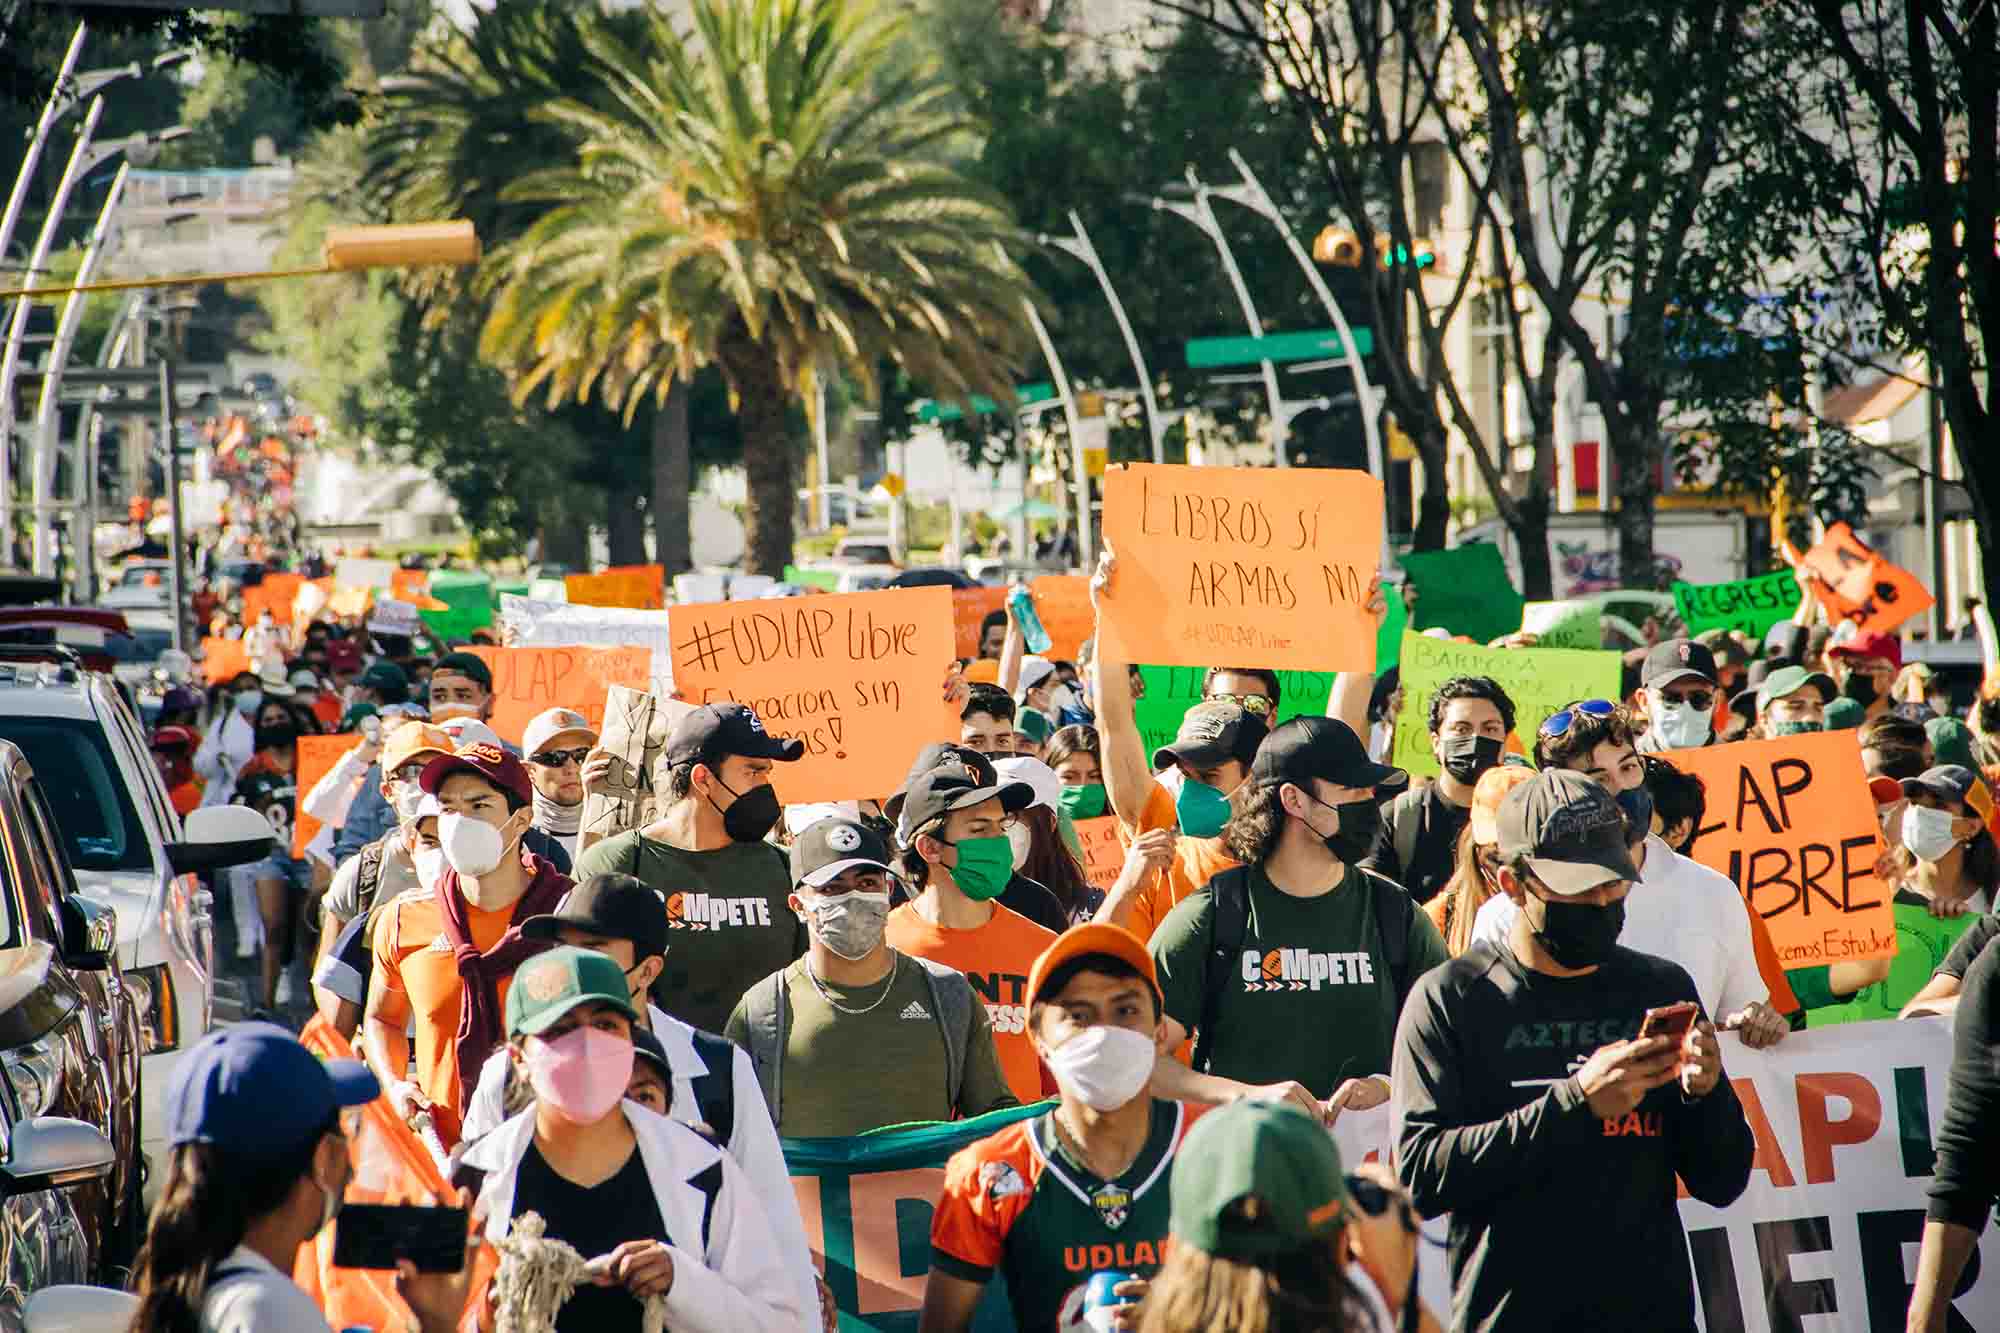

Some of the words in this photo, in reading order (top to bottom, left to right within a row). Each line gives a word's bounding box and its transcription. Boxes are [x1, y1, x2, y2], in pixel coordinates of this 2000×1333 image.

[1141, 476, 1272, 549] LIBROS
[1188, 560, 1297, 609] ARMAS
[1679, 574, 1801, 621] REGRESE
[1729, 834, 1883, 919] IBRE
[655, 889, 772, 932] OMPETE
